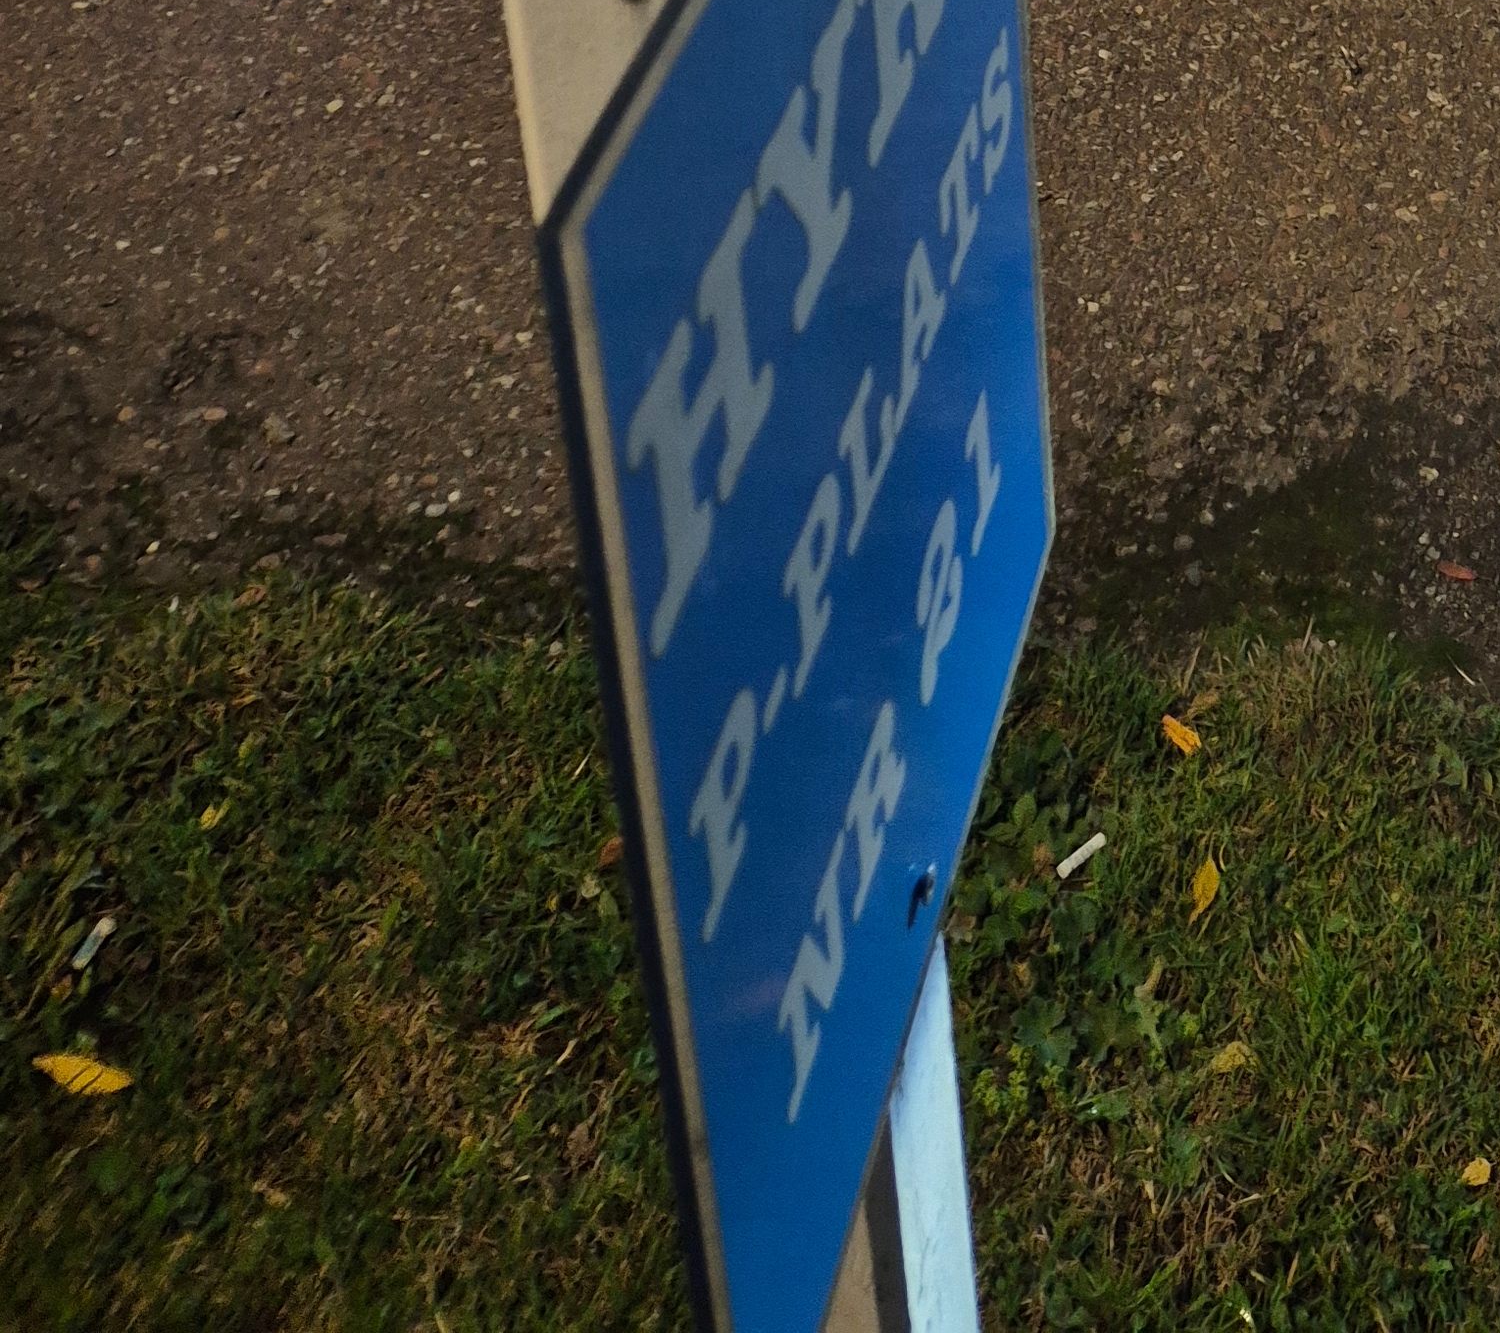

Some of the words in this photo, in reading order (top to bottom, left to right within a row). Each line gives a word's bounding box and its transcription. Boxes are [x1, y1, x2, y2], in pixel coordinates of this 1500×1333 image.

[689, 25, 1013, 944] P-PLATS
[778, 698, 906, 1125] NR
[917, 387, 1001, 708] 21
